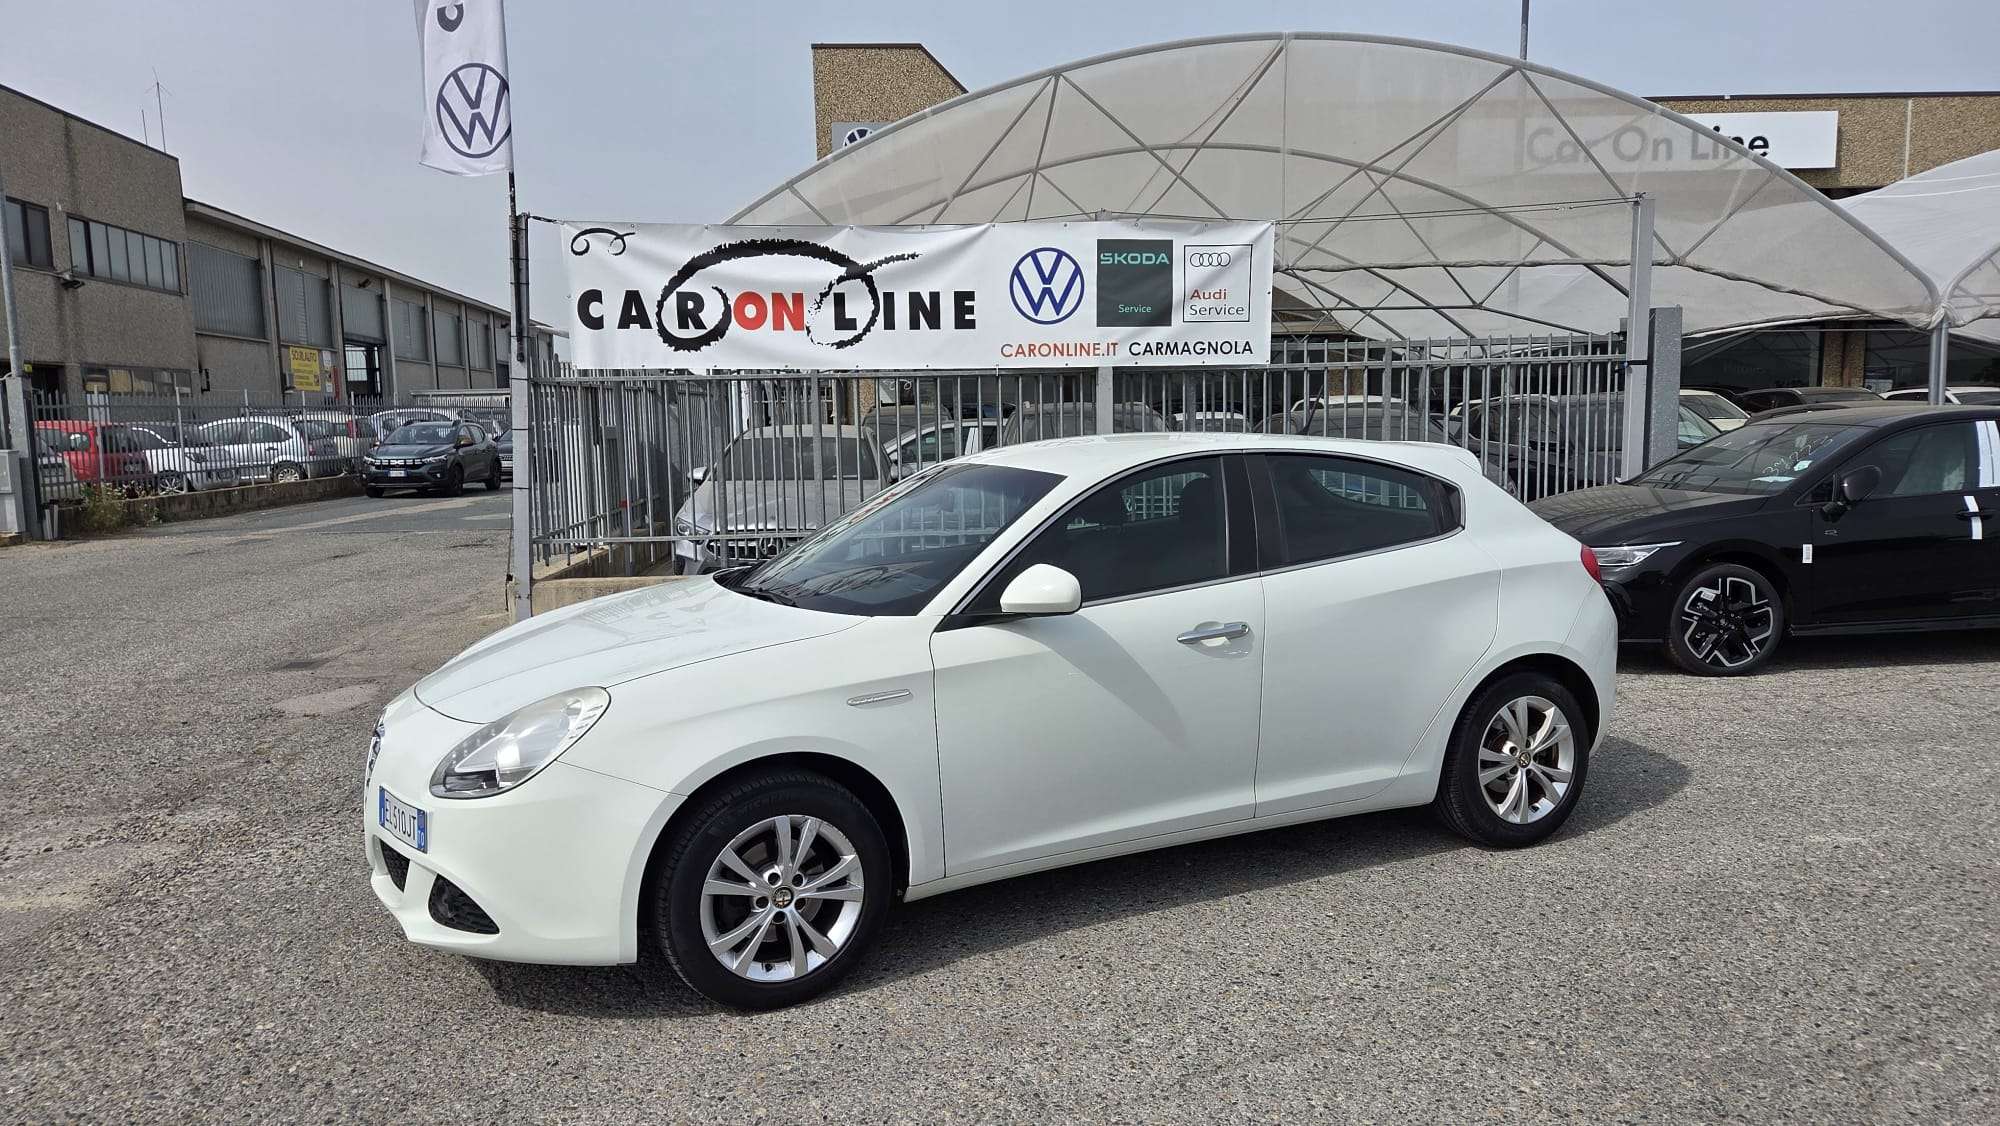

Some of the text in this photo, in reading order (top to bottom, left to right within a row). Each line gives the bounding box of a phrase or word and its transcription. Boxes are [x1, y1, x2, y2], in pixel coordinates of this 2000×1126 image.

[1612, 125, 1673, 162] On
[1190, 288, 1227, 301] Audi
[577, 289, 977, 331] CAR ON LINE
[1118, 304, 1152, 314] Service
[1189, 303, 1245, 317] Service
[1000, 340, 1254, 358] CARONLINE.IT CARMAGNOLA
